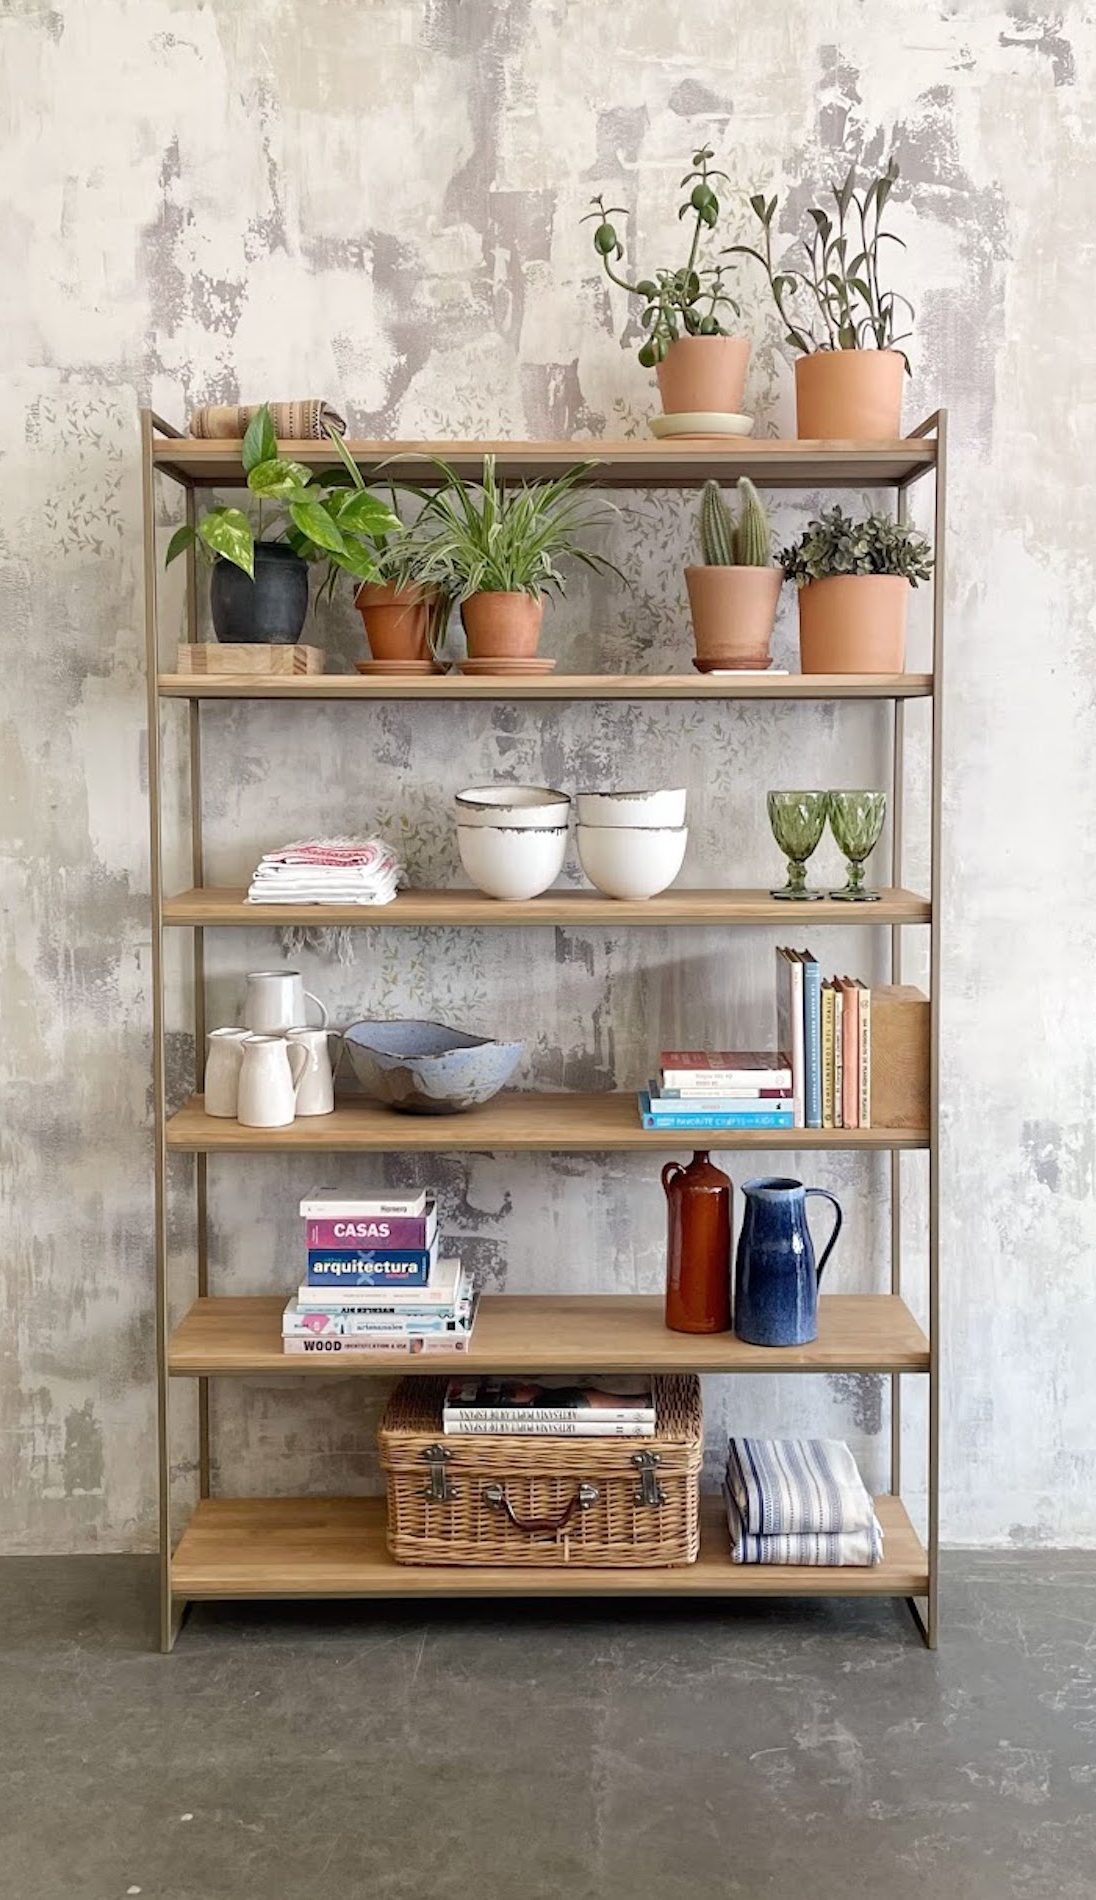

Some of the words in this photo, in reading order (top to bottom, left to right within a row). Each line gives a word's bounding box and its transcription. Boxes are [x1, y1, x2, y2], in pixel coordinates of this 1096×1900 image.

[334, 1223, 391, 1237] CASAS
[313, 1259, 418, 1276] arquitectura
[303, 1341, 342, 1351] WOOD
